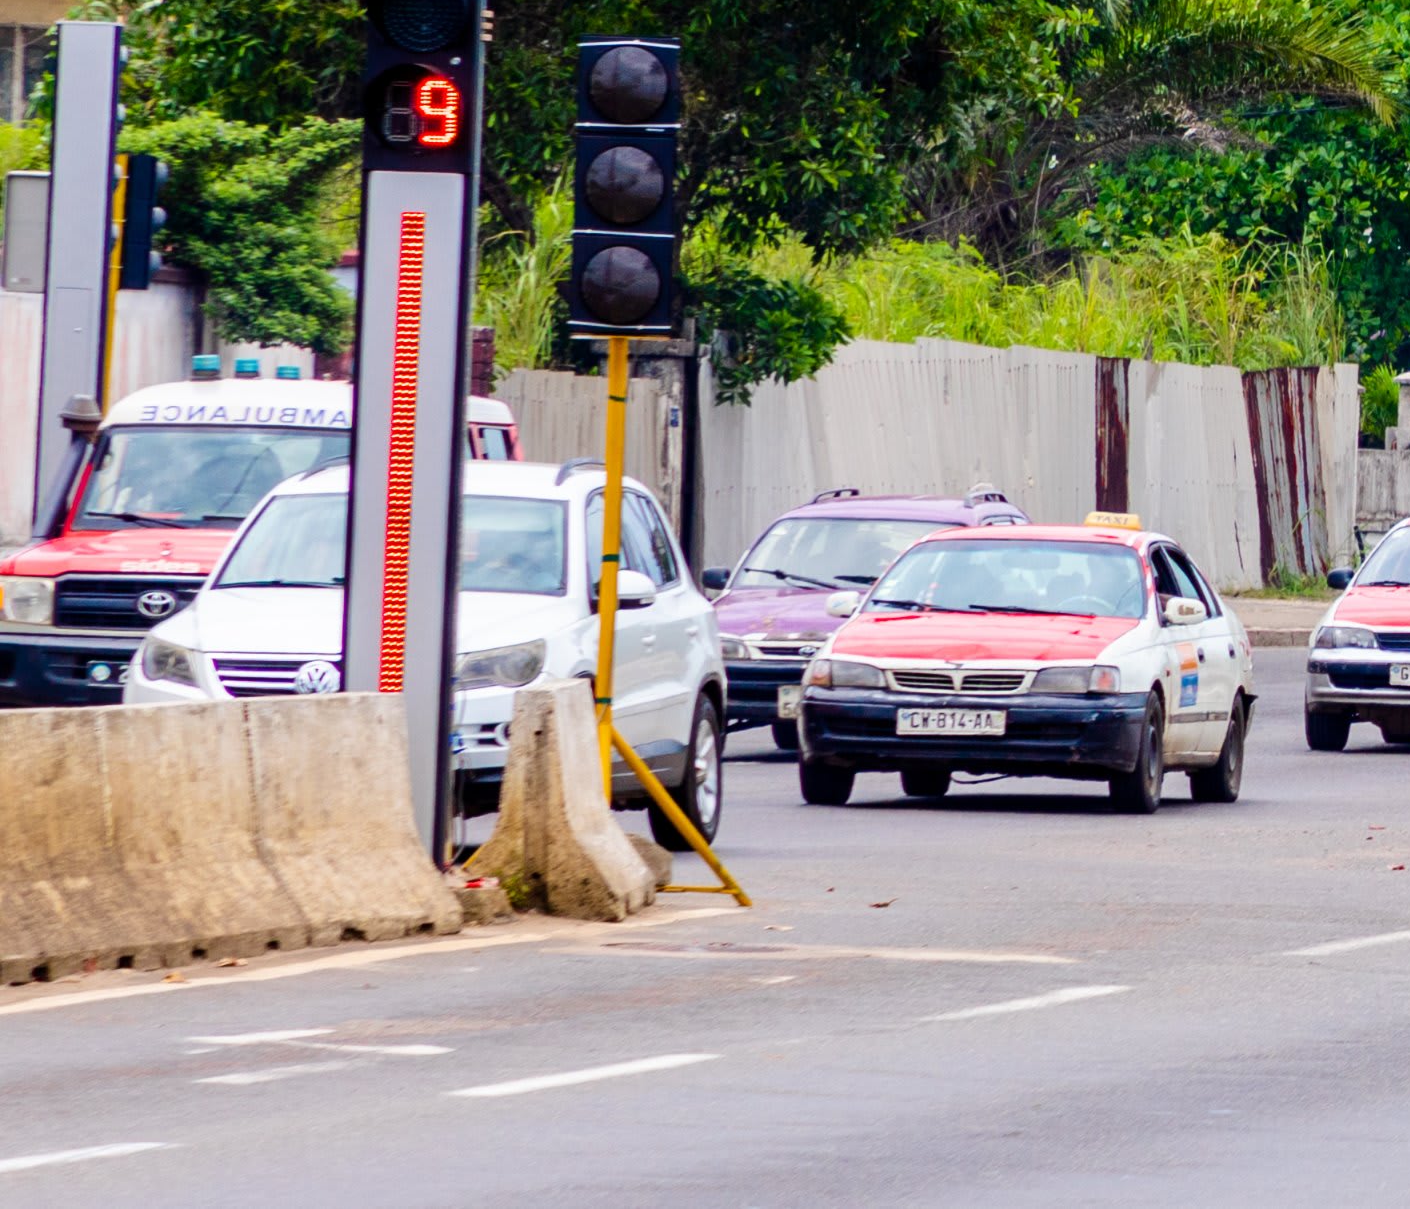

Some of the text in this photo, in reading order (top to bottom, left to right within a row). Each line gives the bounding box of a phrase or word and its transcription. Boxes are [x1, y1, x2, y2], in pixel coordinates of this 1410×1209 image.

[419, 79, 459, 144] 9
[1095, 515, 1129, 525] TAXI
[910, 711, 994, 729] CW-814-AA
